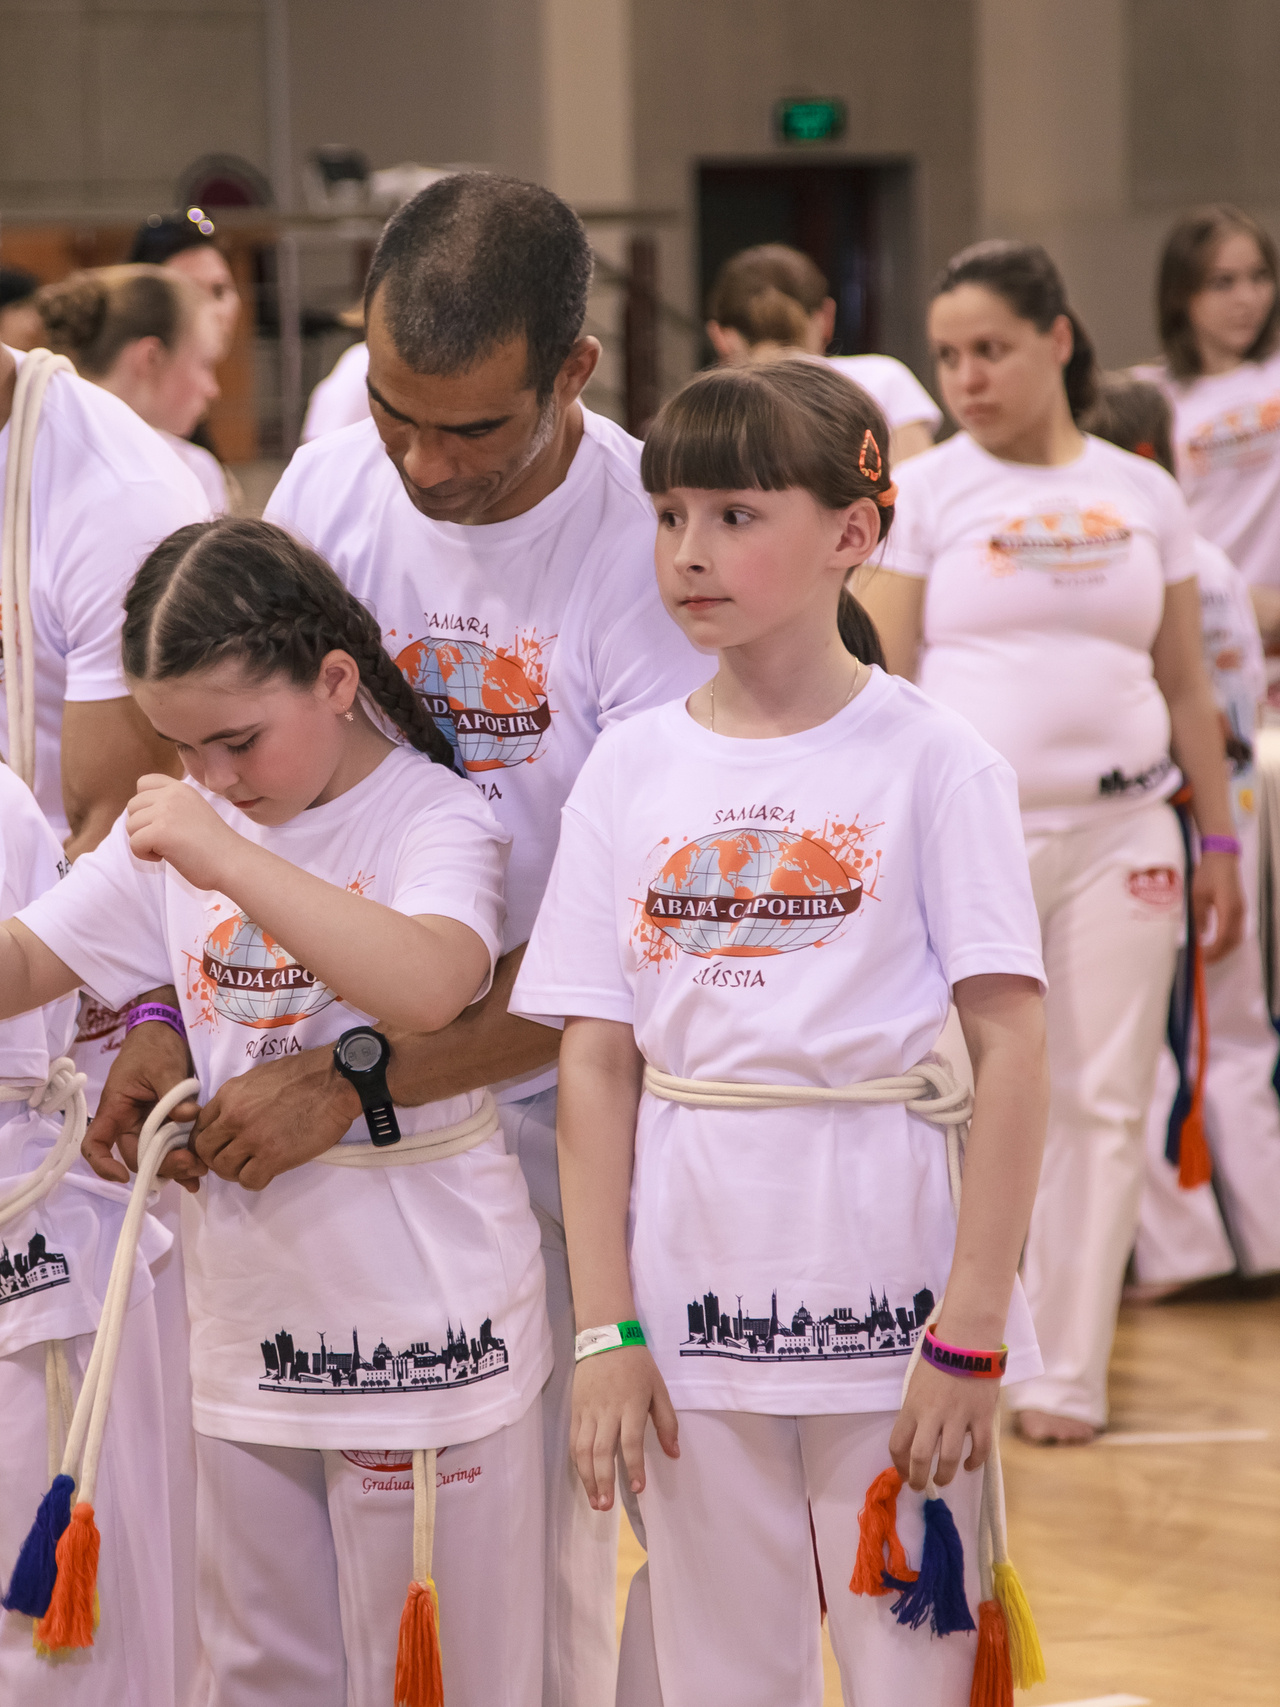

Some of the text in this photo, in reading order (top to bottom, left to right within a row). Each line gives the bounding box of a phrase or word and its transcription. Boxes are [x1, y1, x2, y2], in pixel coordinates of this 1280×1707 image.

[424, 612, 490, 639] AMARA
[713, 804, 796, 825] SAMARA
[934, 1346, 992, 1373] SAMARA
